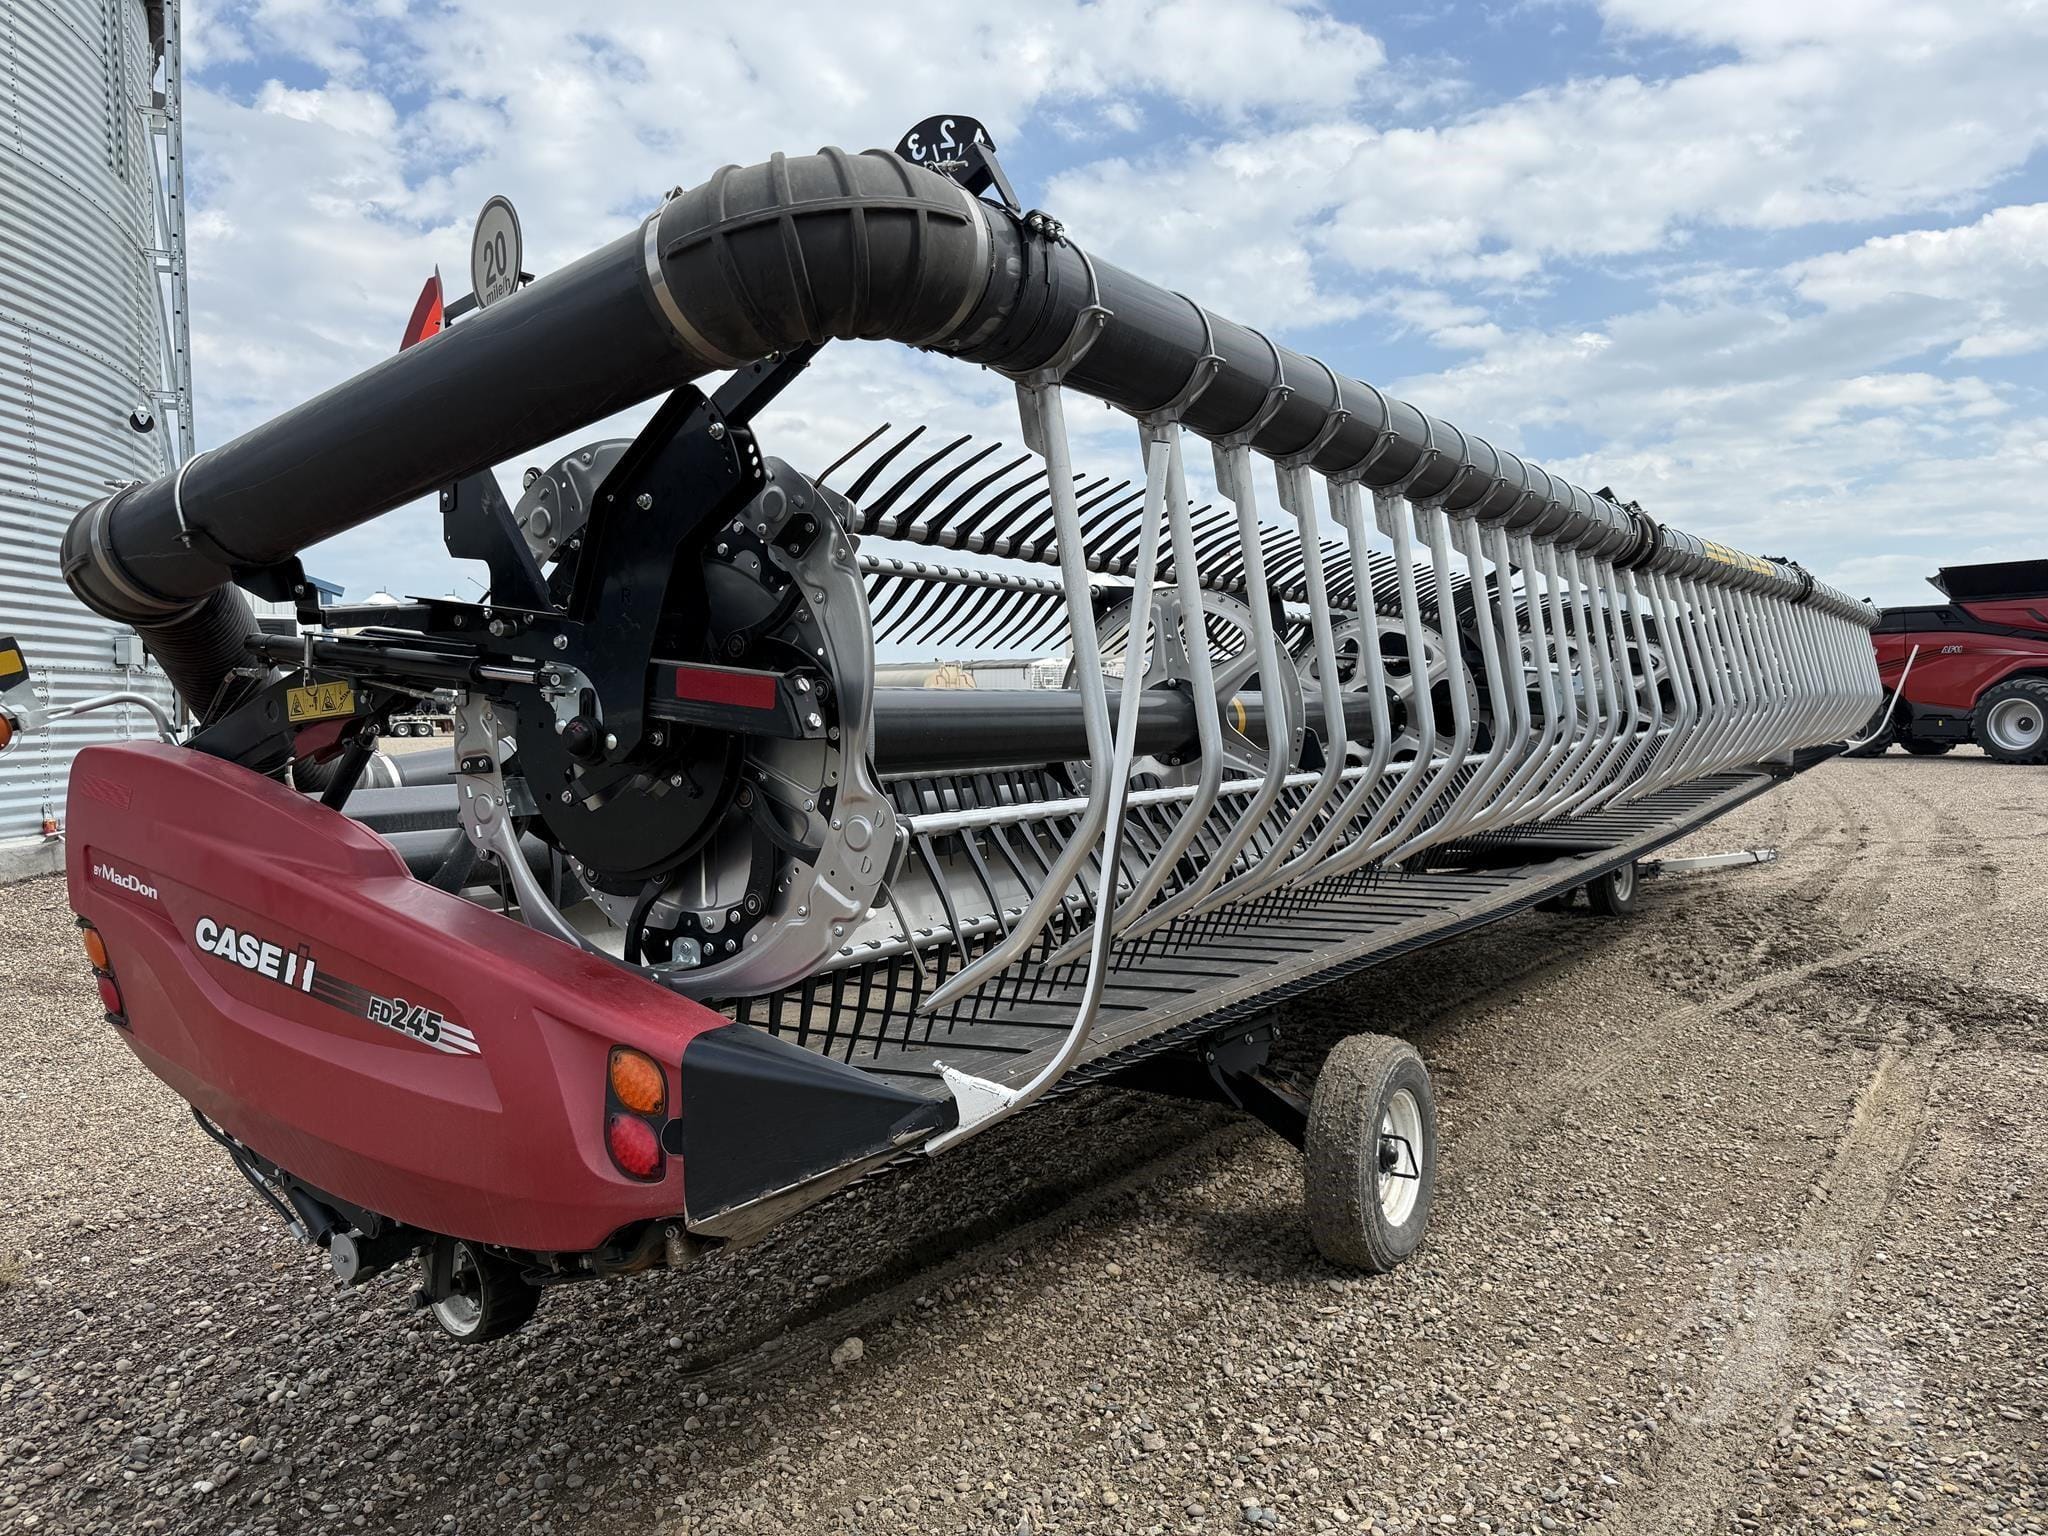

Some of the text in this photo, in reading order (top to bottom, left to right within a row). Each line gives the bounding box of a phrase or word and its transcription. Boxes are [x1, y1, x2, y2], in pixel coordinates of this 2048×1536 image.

[483, 230, 507, 289] 20
[93, 863, 158, 900] BY MacDon
[195, 917, 283, 979] CASE
[367, 995, 444, 1045] FD245
